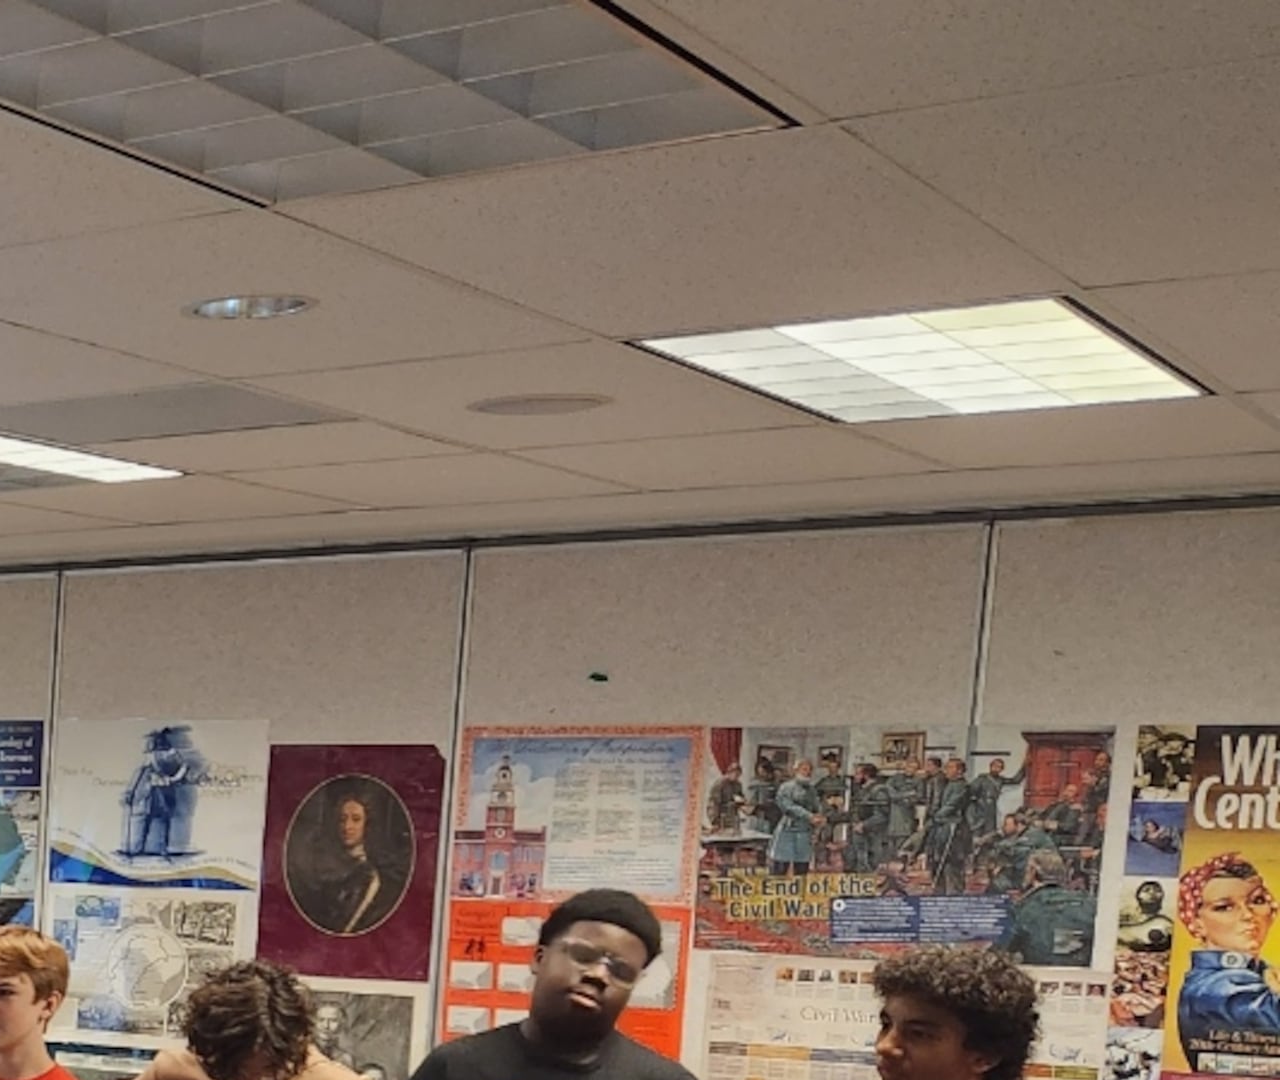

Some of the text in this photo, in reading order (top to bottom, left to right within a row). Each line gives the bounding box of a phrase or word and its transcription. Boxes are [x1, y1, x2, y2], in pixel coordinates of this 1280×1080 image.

[717, 875, 876, 897] The End of the
[729, 898, 823, 918] Civil War
[800, 1004, 877, 1024] Civil War
